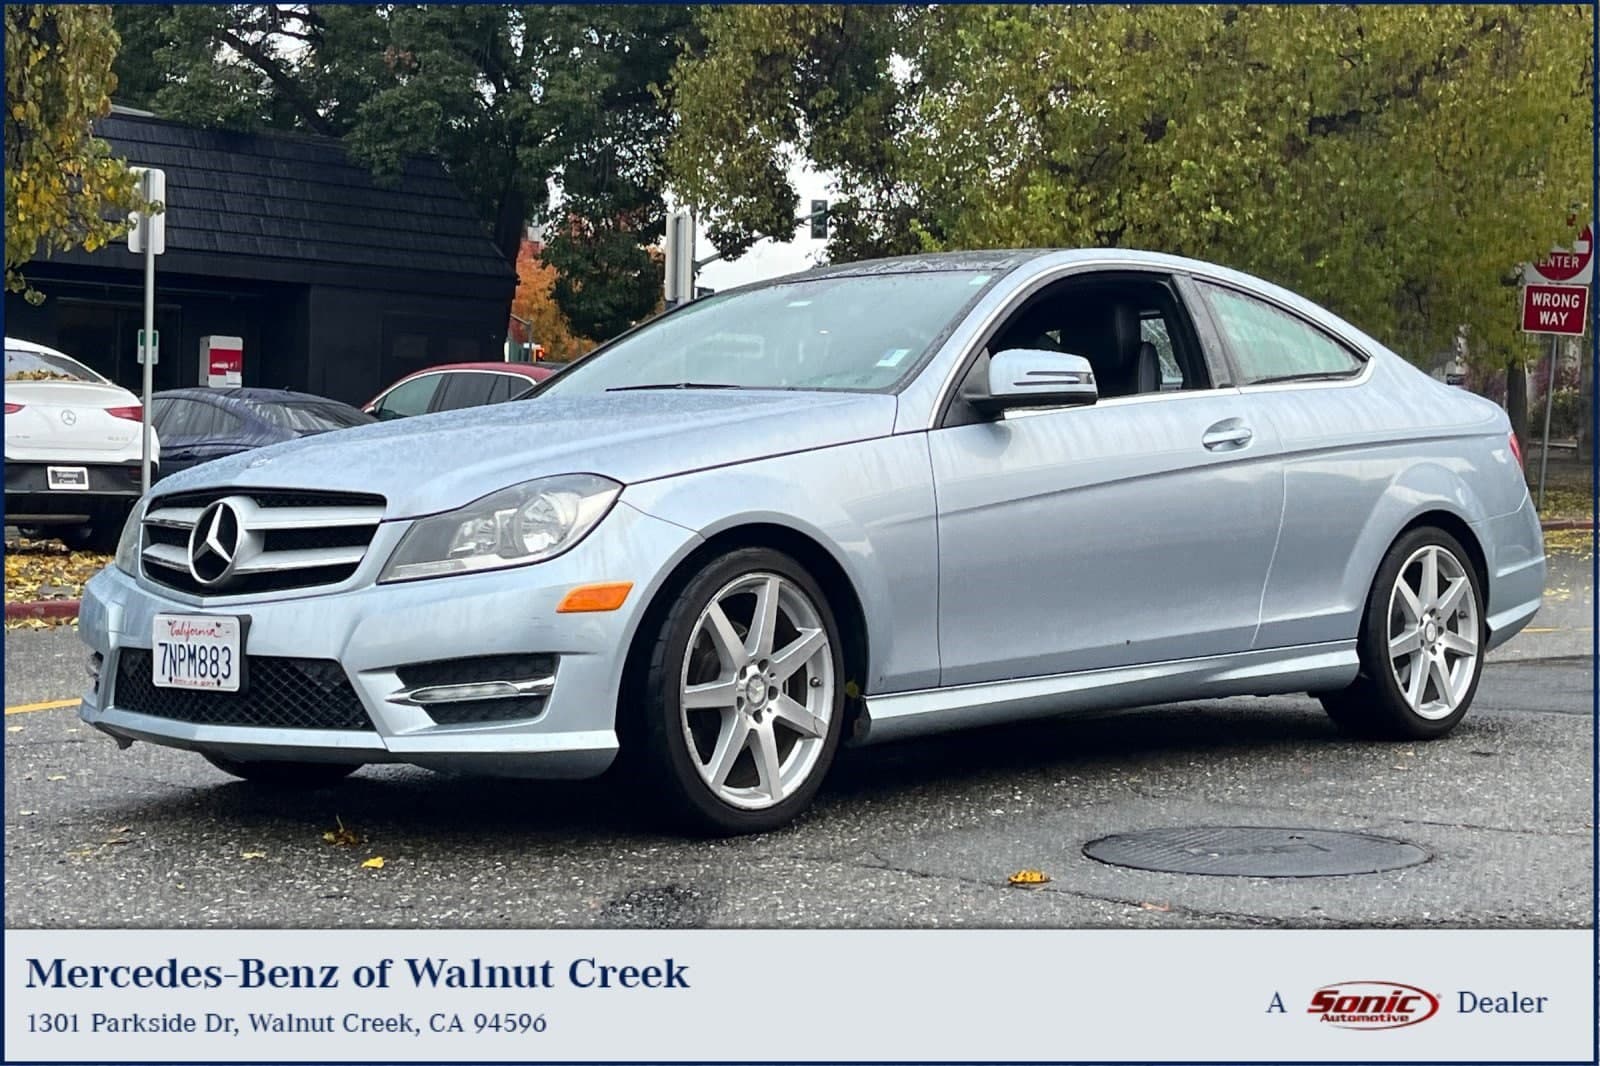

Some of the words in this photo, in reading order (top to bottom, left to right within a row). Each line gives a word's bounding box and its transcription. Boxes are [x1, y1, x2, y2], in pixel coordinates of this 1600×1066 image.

[1540, 256, 1579, 268] ENTER
[1532, 292, 1580, 308] WRONG
[1540, 311, 1569, 325] WAY
[169, 620, 222, 641] California
[158, 642, 231, 679] 7NPM883
